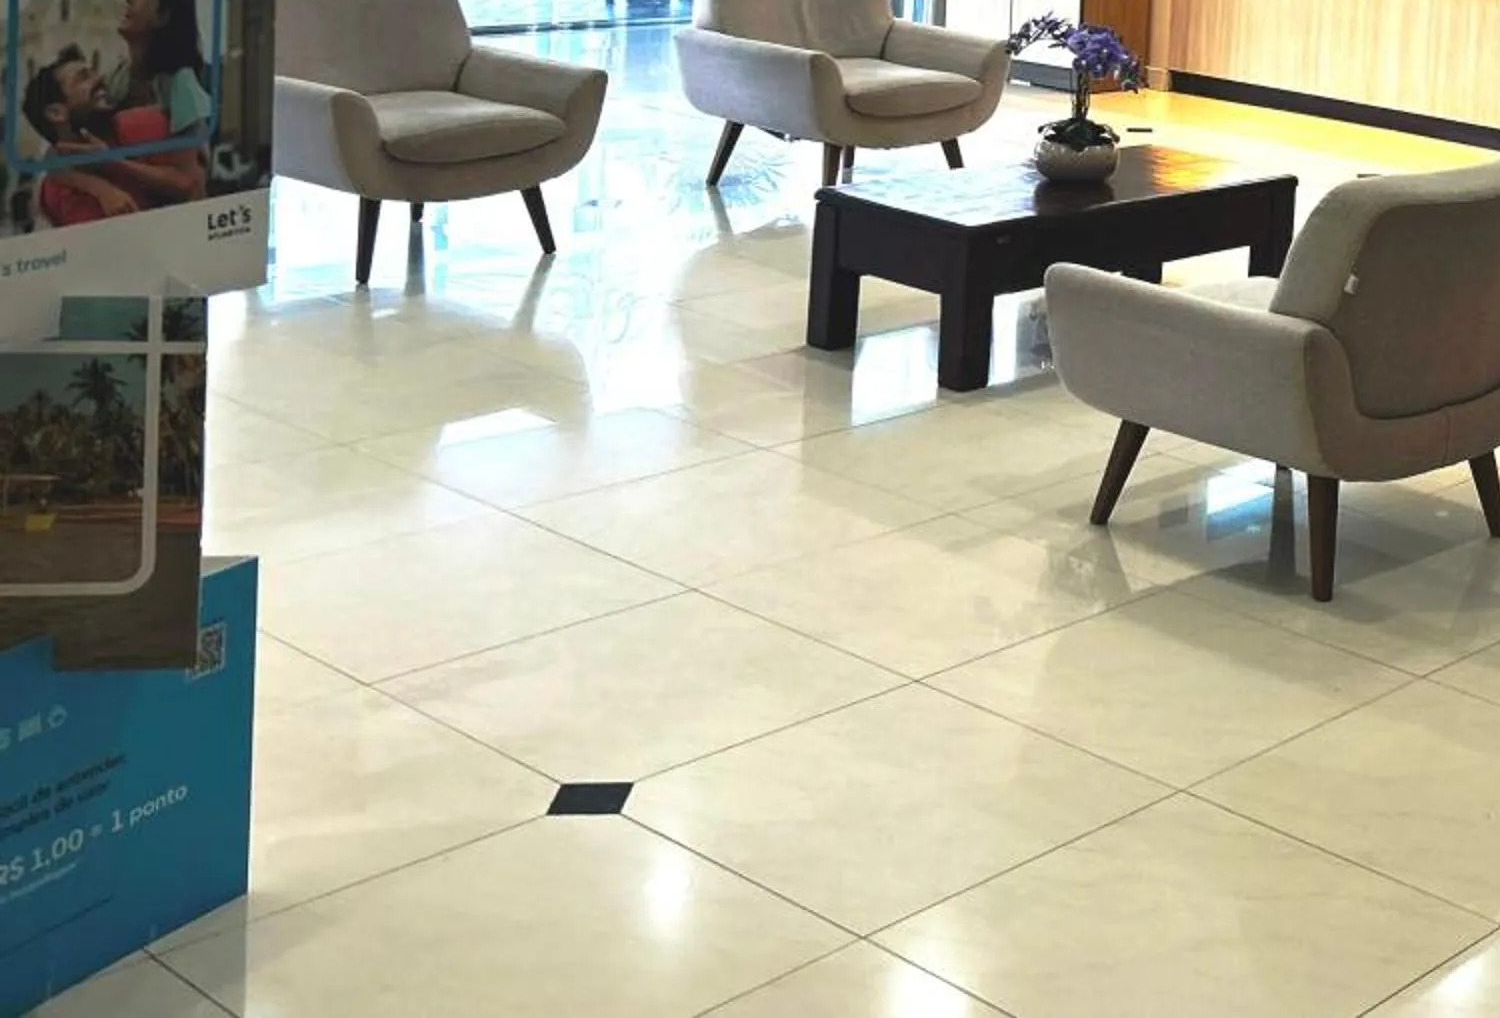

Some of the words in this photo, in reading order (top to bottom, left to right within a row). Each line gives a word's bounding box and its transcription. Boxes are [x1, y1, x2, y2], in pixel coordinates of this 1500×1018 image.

[207, 204, 252, 231] Let's
[16, 247, 68, 273] travel
[111, 808, 125, 833] 1
[129, 785, 189, 827] ponto
